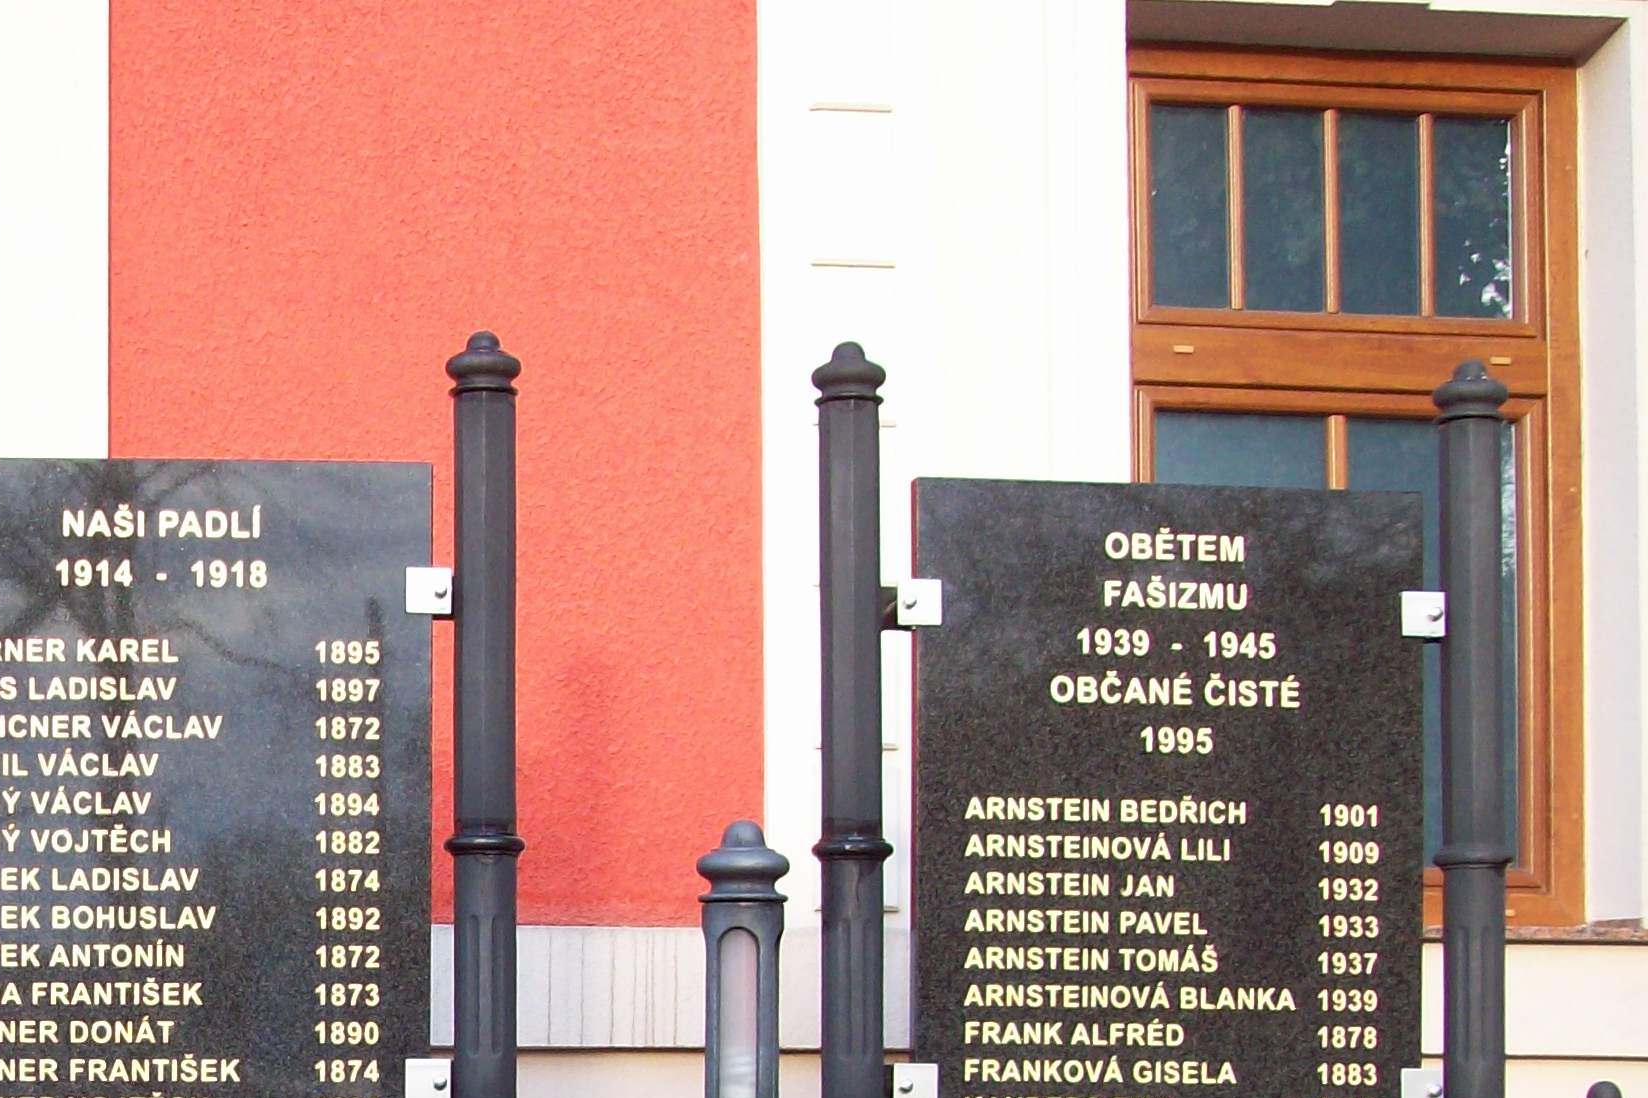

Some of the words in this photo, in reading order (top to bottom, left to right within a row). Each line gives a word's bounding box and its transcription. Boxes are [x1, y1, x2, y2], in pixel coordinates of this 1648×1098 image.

[62, 503, 146, 538] NAŠI
[158, 503, 262, 539] PADLÍ
[1104, 527, 1245, 563] OBĚTEM
[55, 558, 134, 588] 1914
[190, 559, 269, 589] 1918
[1103, 575, 1248, 611] FAŠIZMU
[76, 638, 179, 663] KAREL
[315, 640, 380, 665] 1895
[1076, 627, 1150, 657] 1939
[1203, 630, 1276, 660] 1945
[28, 675, 177, 701] LADISLAV
[315, 677, 381, 703] 1897
[1050, 670, 1193, 706] OBČANÉ
[1204, 672, 1301, 708] ČISTÉ
[101, 709, 224, 741] VÁCLAV
[314, 715, 381, 741] 1872
[1140, 725, 1214, 755] 1995
[37, 747, 160, 778] VÁCLAV
[315, 753, 381, 779] 1883
[30, 784, 152, 816] VÁCLAV
[314, 790, 380, 817] 1894
[964, 796, 1110, 822] ARNSTEIN
[1120, 795, 1247, 825] BEDŘICH
[1319, 803, 1378, 828] 1901
[30, 823, 171, 854] VOJTĚCH
[315, 830, 380, 855] 1882
[964, 832, 1172, 861] ARNSTEINOVÁ
[1180, 838, 1230, 862] LILI
[1318, 840, 1380, 865] 1909
[51, 867, 199, 892] LADISLAV
[314, 868, 381, 893] 1874
[964, 871, 1110, 897] ARNSTEIN
[1120, 874, 1175, 898] JAN
[1318, 877, 1379, 902] 1932
[51, 904, 217, 930] BOHUSLAV
[315, 906, 381, 931] 1892
[964, 908, 1110, 934] ARNSTEIN
[1119, 910, 1208, 936] PAVEL
[1318, 914, 1379, 939] 1933
[963, 946, 1109, 971] ARNSTEIN
[1118, 943, 1219, 973] TOMÁŠ
[1317, 951, 1378, 975] 1937
[31, 976, 203, 1006] FRANTIŠEK
[314, 983, 380, 1007] 1873
[963, 980, 1170, 1009] ARNSTEINOVÁ
[1180, 986, 1297, 1011] BLANKA
[1317, 988, 1378, 1012] 1939
[69, 1015, 175, 1044] DONÁT
[314, 1020, 380, 1045] 1890
[964, 1021, 1063, 1045] FRANK
[1070, 1018, 1185, 1047] ALFRÉD
[1317, 1025, 1377, 1049] 1878
[69, 1053, 241, 1083] FRANTIŠEK
[314, 1059, 380, 1083] 1874
[964, 1055, 1124, 1083] FRANKOVÁ
[1132, 1060, 1237, 1085] GISELA
[1317, 1062, 1378, 1086] 1883
